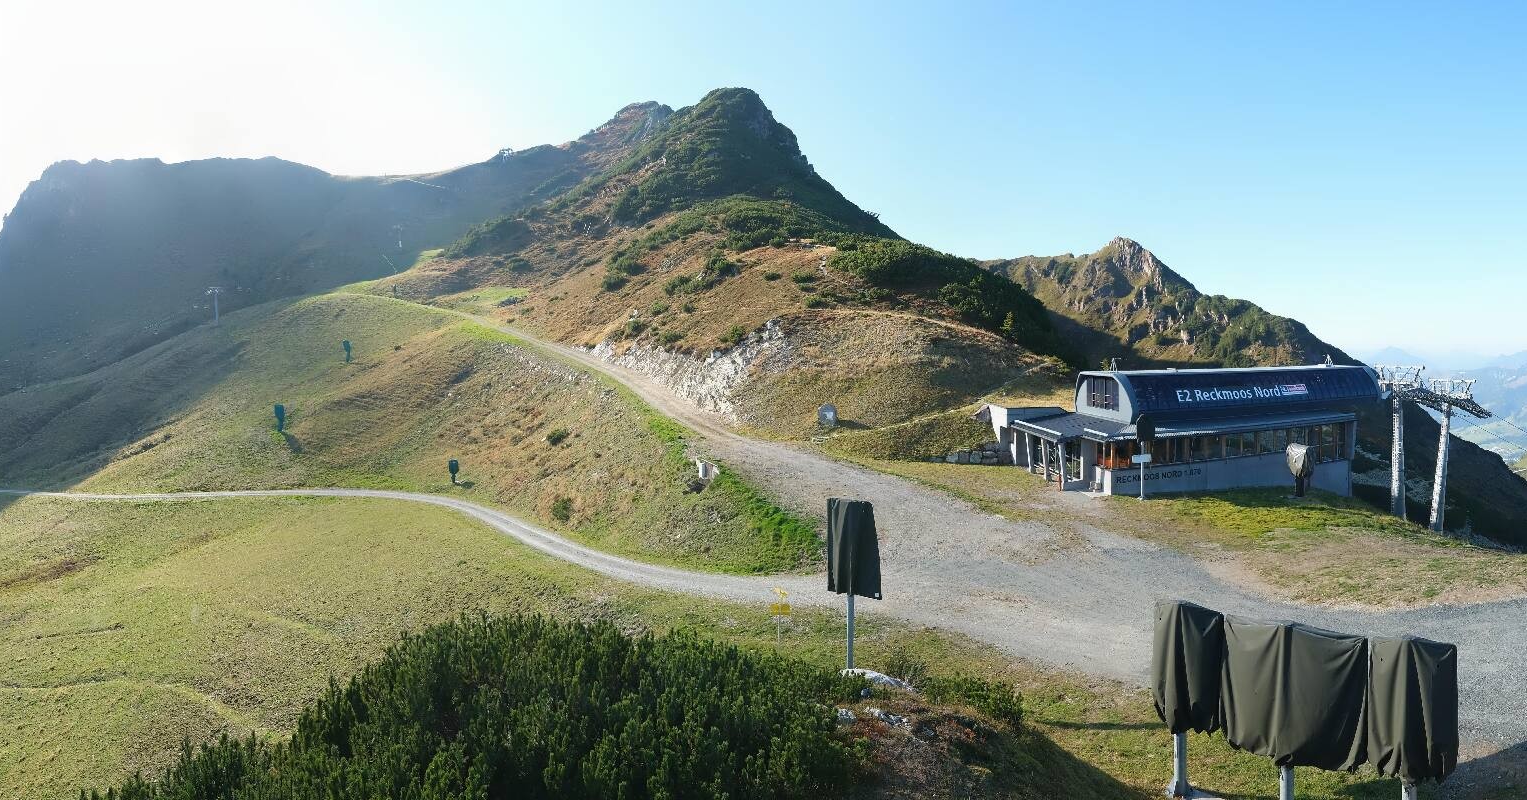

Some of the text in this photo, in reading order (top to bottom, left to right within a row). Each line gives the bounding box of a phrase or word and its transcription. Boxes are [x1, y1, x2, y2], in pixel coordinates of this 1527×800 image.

[1176, 389, 1193, 402] E2
[1194, 387, 1253, 402] Reckmoos
[1253, 385, 1281, 398] Nord
[1161, 470, 1183, 480] NORD
